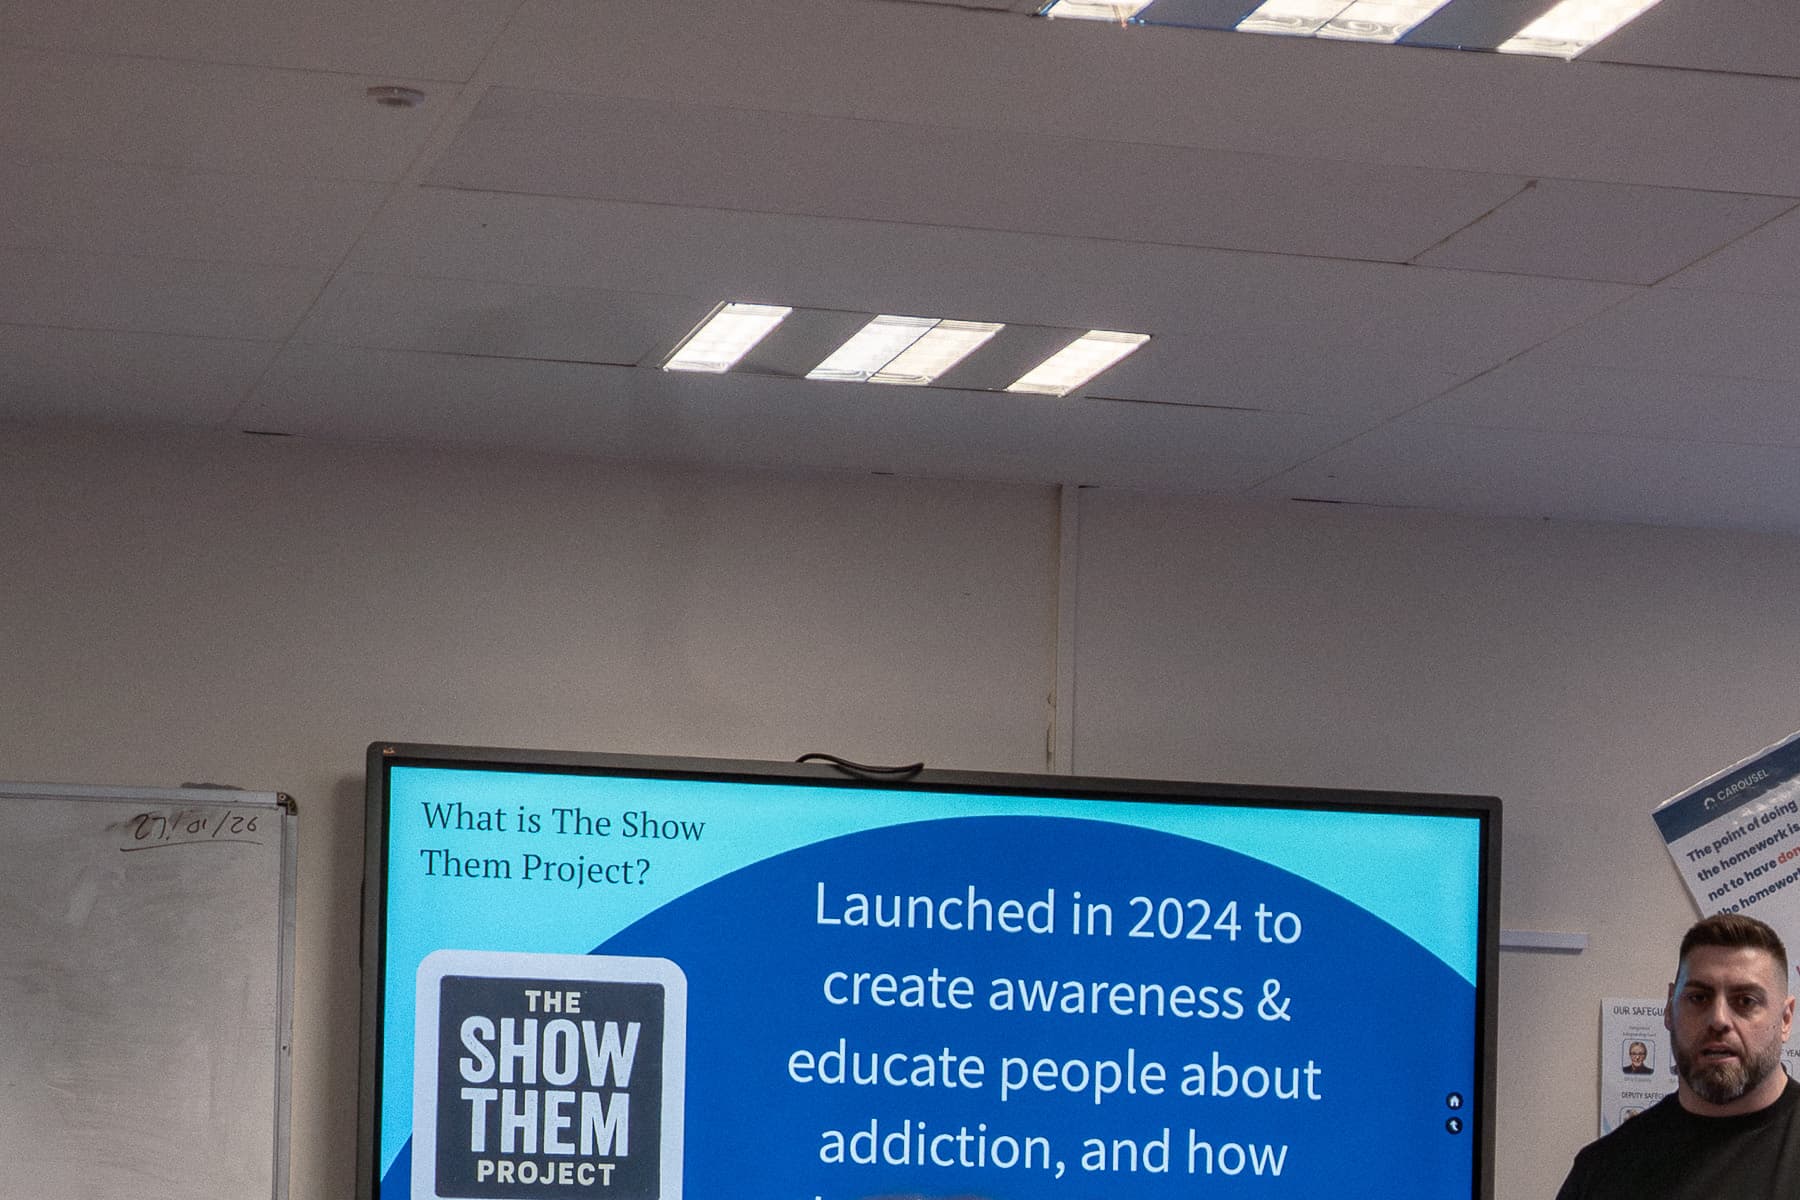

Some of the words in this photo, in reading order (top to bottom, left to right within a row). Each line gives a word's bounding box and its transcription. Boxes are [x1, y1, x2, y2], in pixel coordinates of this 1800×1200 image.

[1717, 769, 1770, 801] CAROUSEL
[421, 802, 506, 831] What
[518, 806, 540, 833] is
[552, 808, 610, 836] The
[623, 811, 705, 840] Show
[1687, 845, 1712, 862] The
[1712, 826, 1746, 853] point
[1748, 817, 1761, 832] of
[1761, 800, 1798, 824] doing
[421, 849, 511, 878] Them
[522, 854, 649, 888] Project?
[1697, 865, 1720, 881] the
[1720, 830, 1788, 870] homework
[1790, 822, 1800, 836] is
[1708, 884, 1732, 901] not
[1730, 876, 1745, 889] to
[1745, 859, 1777, 881] have
[817, 882, 1054, 933] Launched
[1074, 892, 1111, 935] in
[1129, 897, 1241, 940] 2024
[1255, 904, 1301, 943] to
[525, 990, 580, 1013] THE
[824, 968, 973, 1009] create
[990, 979, 1243, 1019] awareness
[1258, 979, 1290, 1021] &
[1613, 1007, 1630, 1015] OUR
[1633, 1007, 1665, 1016] SAFEGU
[460, 1016, 640, 1090] SHOW
[789, 1039, 984, 1088] educate
[1002, 1049, 1165, 1104] people
[1181, 1052, 1321, 1100] about
[461, 1088, 629, 1156] THEM
[478, 1160, 615, 1185] PROJECT
[820, 1119, 1065, 1179] addiction,
[1082, 1128, 1169, 1172] and
[1189, 1129, 1287, 1176] how
